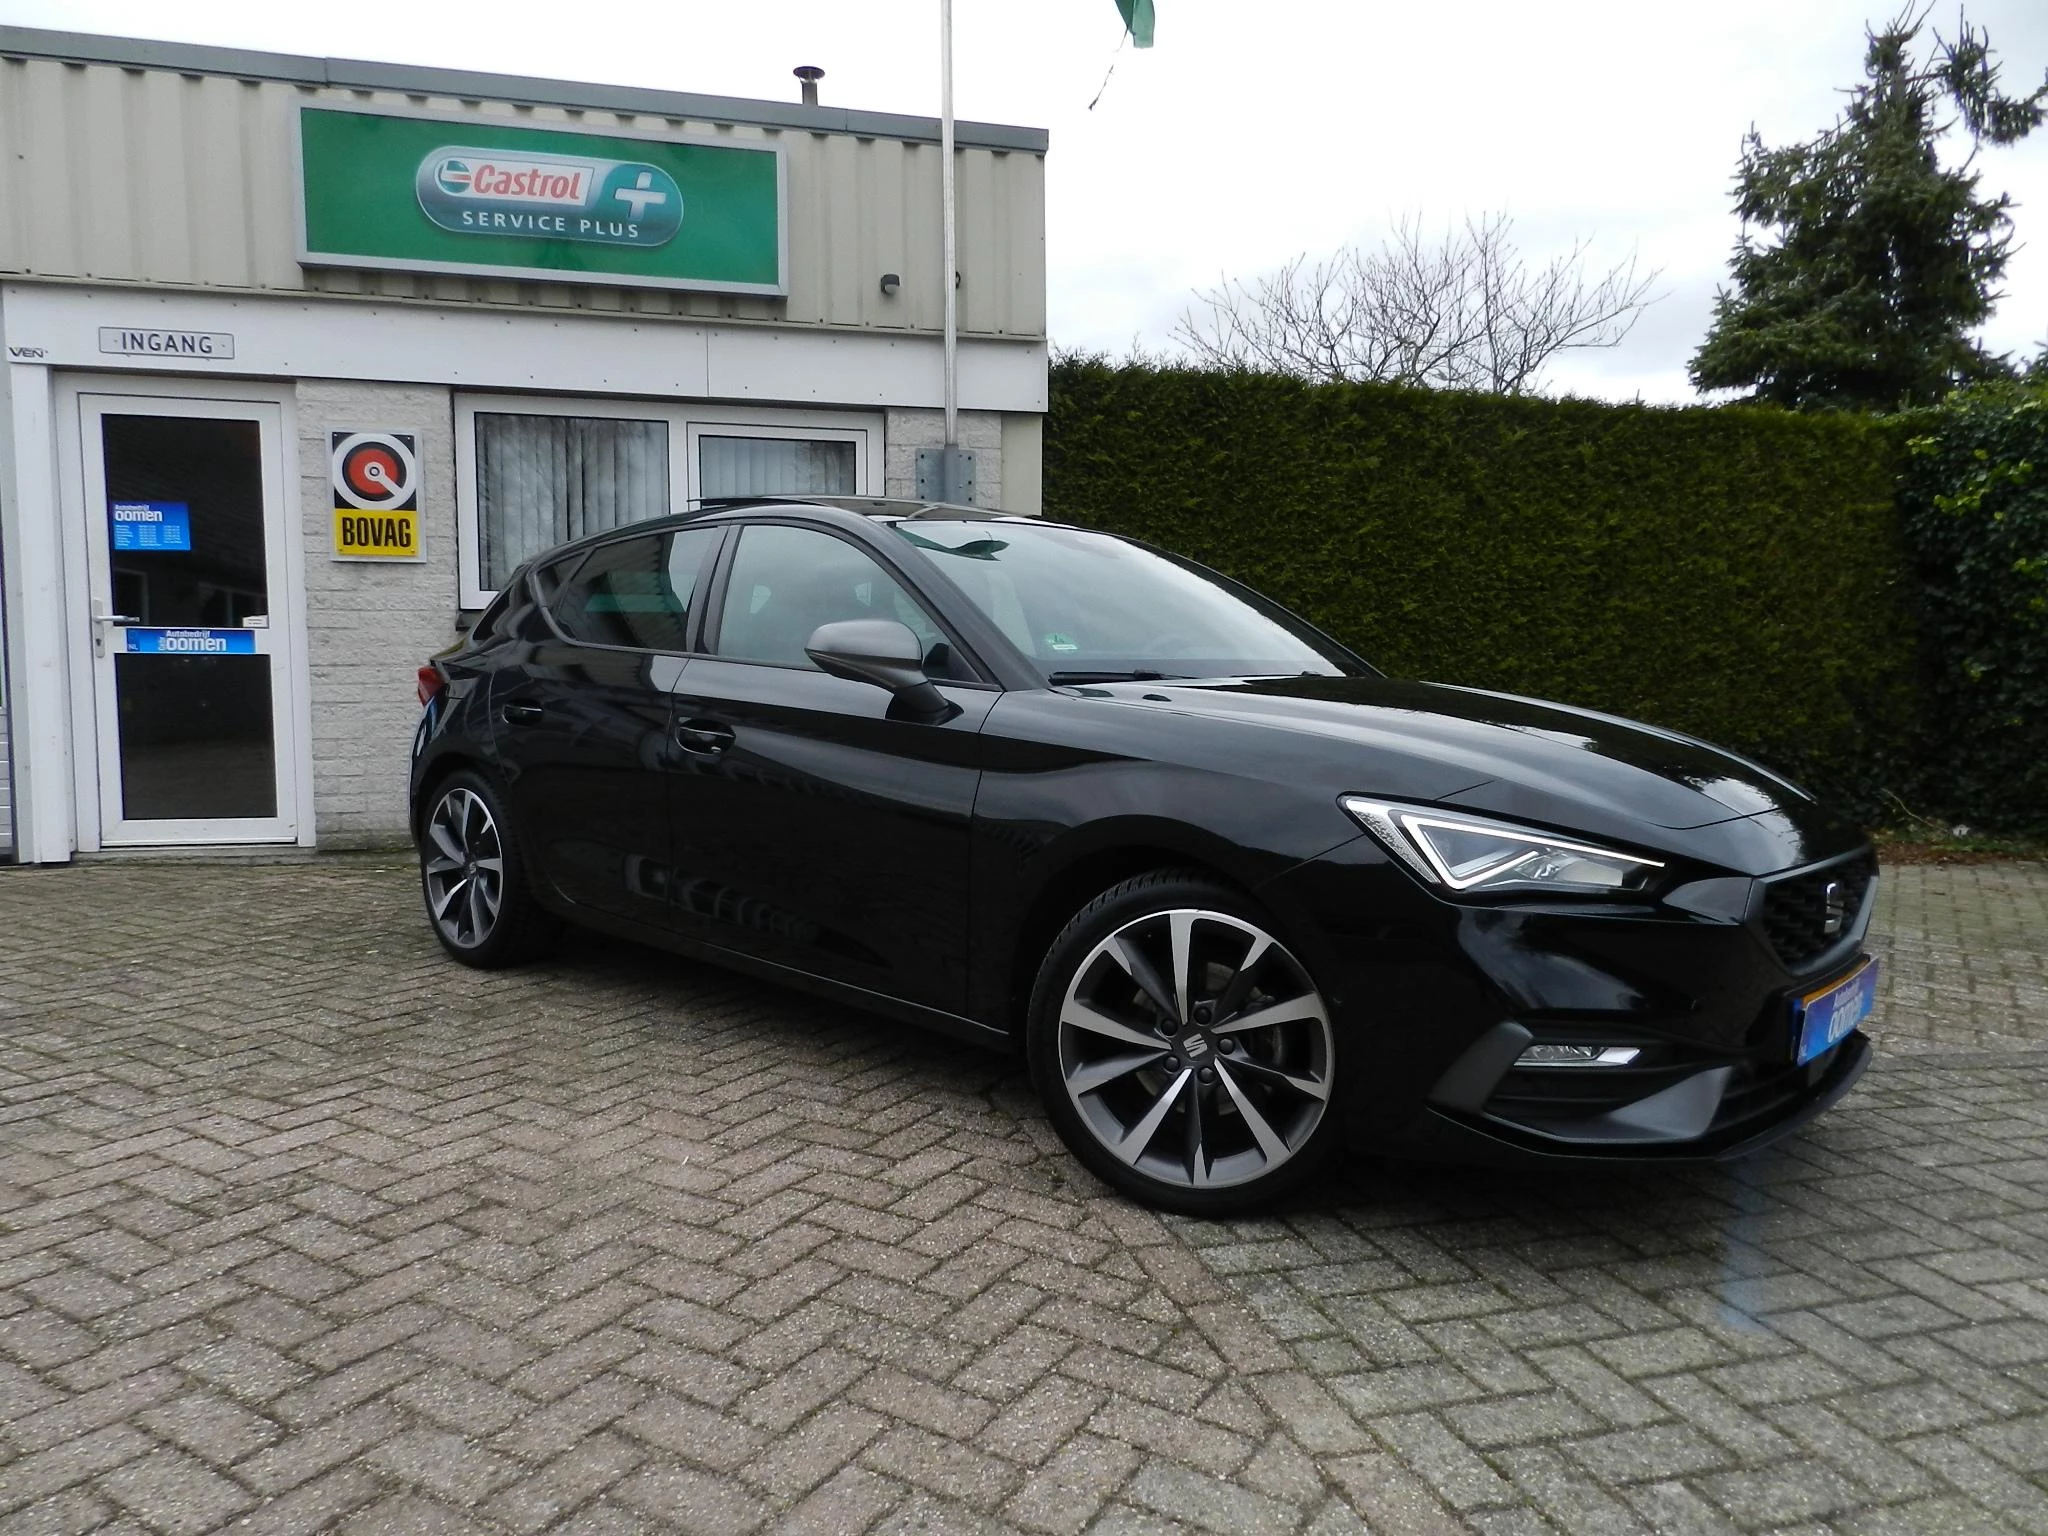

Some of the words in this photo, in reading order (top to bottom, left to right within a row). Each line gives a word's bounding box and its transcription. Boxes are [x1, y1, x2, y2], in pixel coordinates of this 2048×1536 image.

[474, 164, 581, 200] Castrol
[463, 211, 566, 232] SERVICE
[580, 219, 639, 238] PLUS
[121, 331, 213, 354] INGANG
[115, 510, 163, 522] oomen
[342, 517, 411, 547] BOVAG
[166, 630, 211, 639] Autobedrijf
[166, 637, 227, 651] oomen
